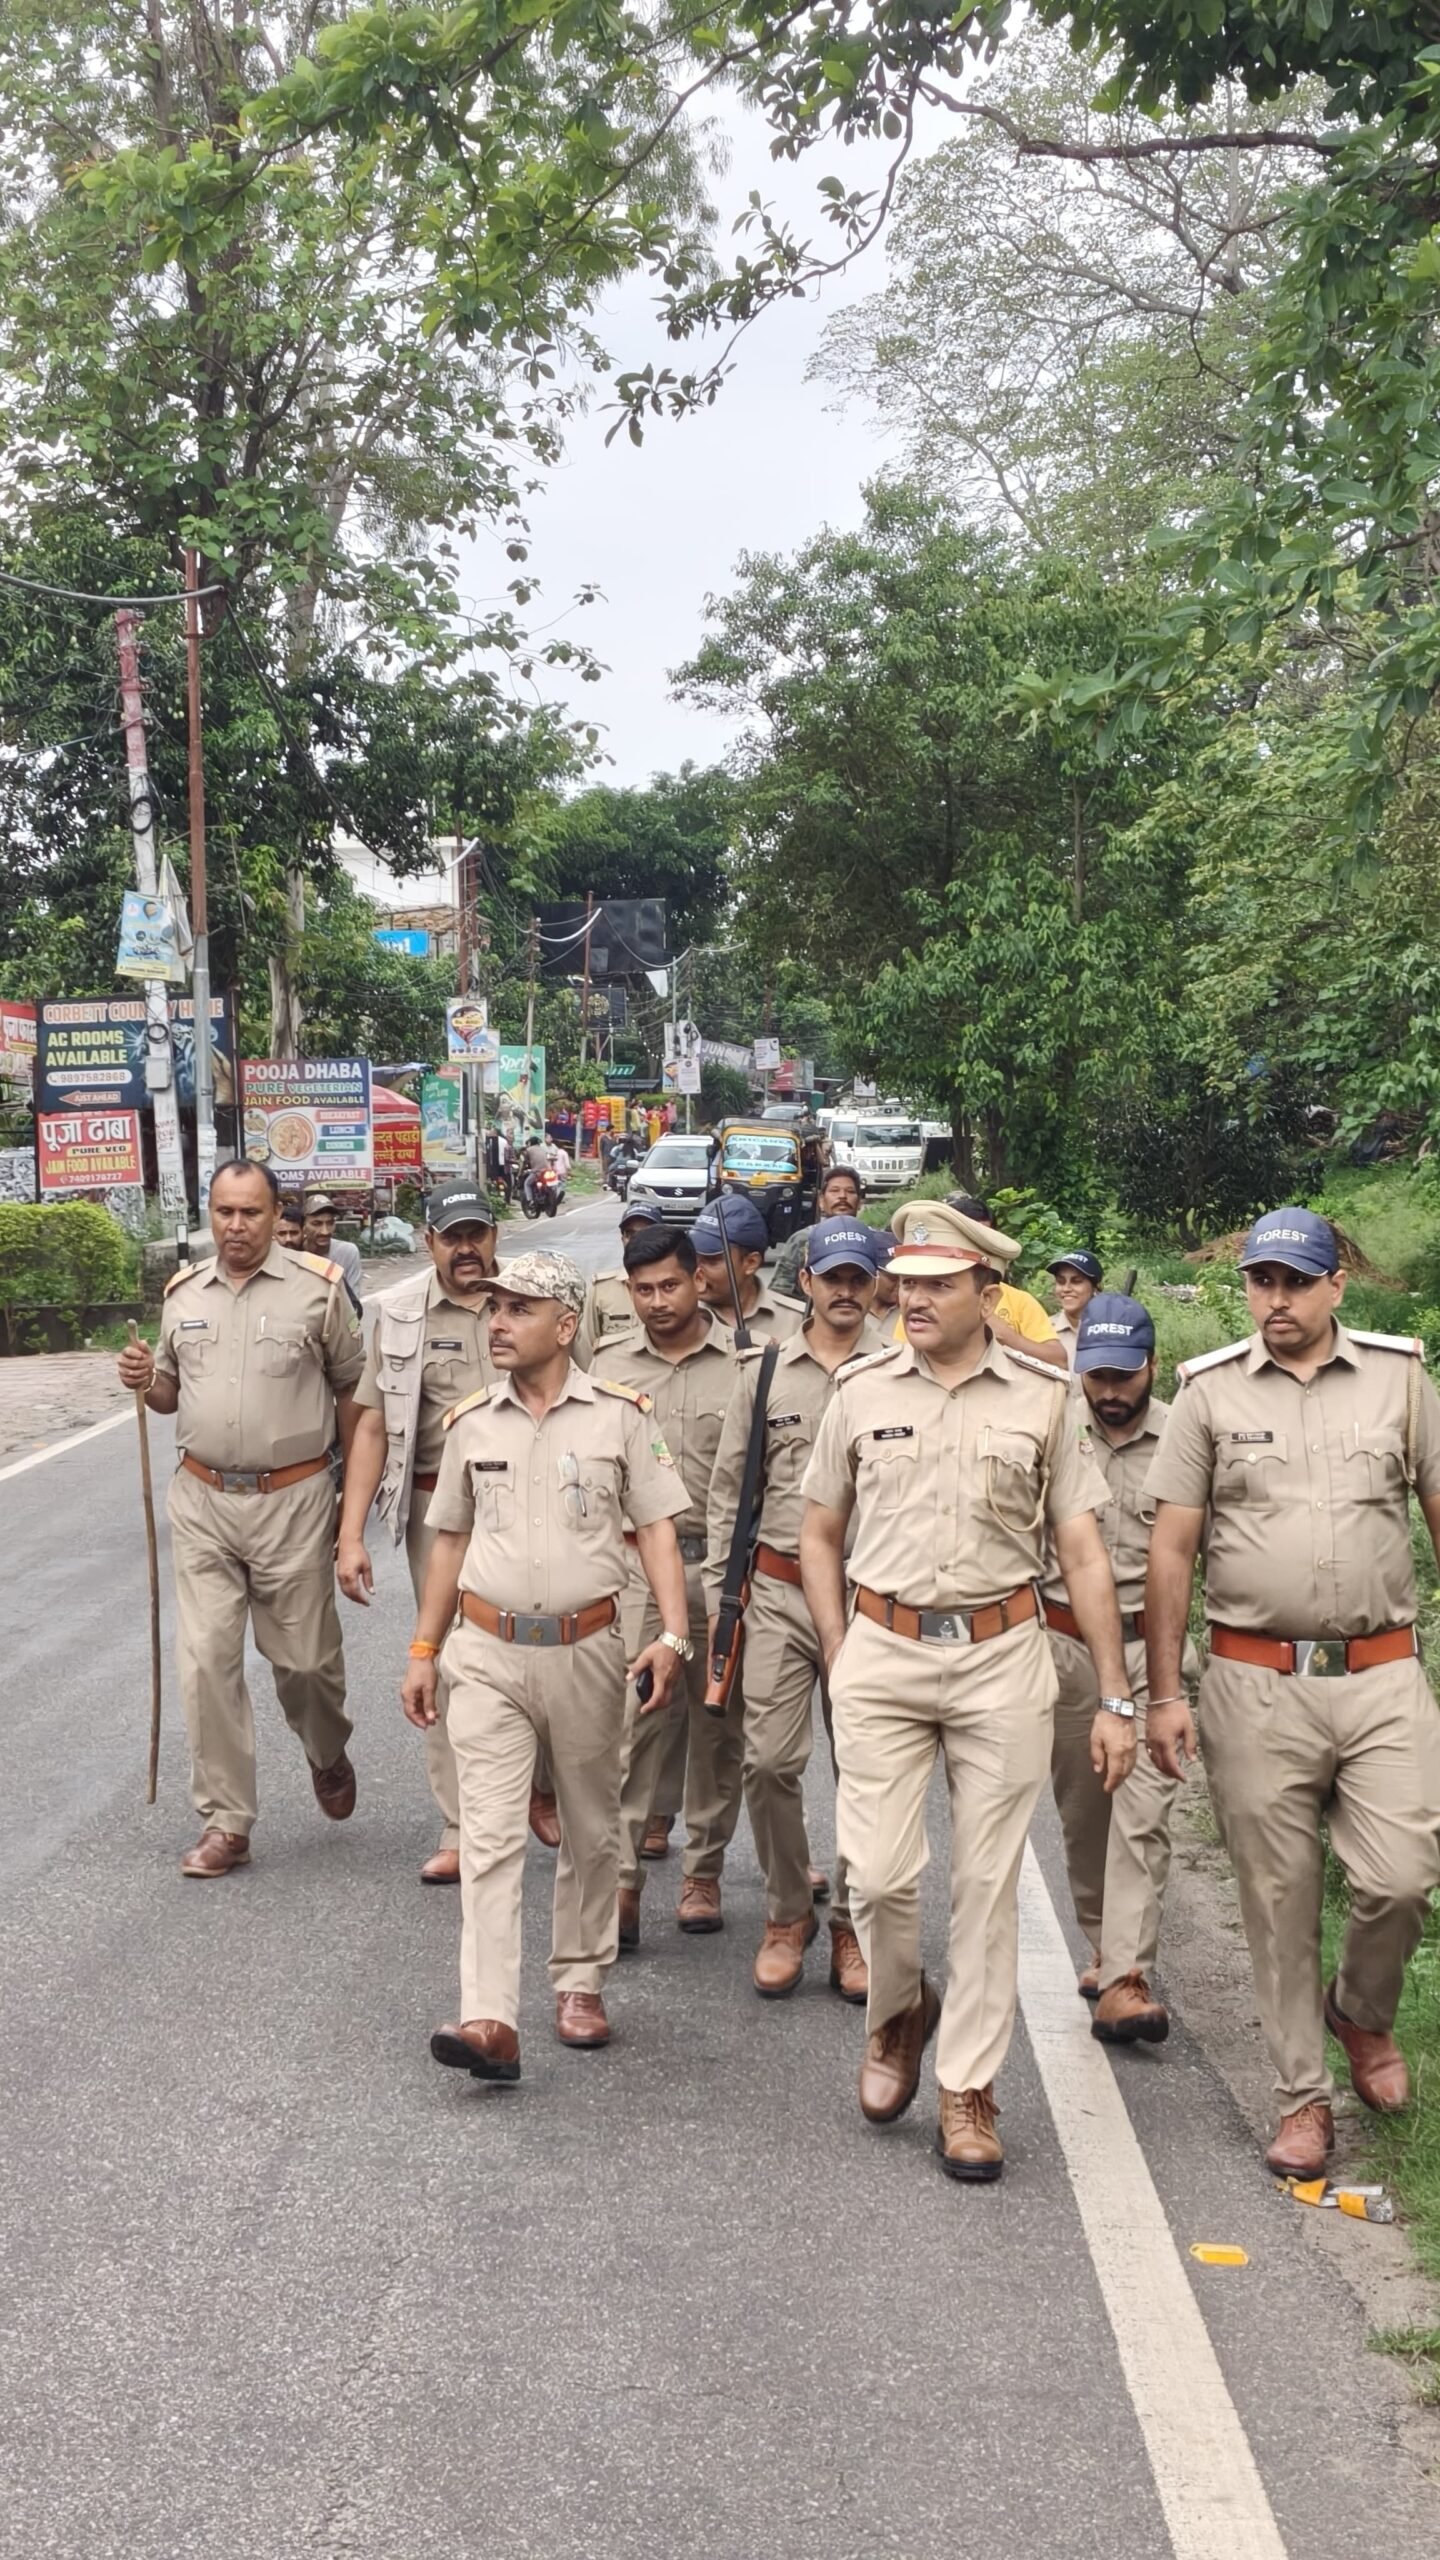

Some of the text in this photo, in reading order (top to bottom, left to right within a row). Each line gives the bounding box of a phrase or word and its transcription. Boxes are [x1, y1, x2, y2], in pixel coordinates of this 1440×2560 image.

[43, 1003, 107, 1024] CORBETT
[108, 1001, 177, 1022] COUNY
[47, 1030, 125, 1047] AC ROOMS
[46, 1049, 128, 1067] AVAILABLE
[499, 1053, 541, 1073] Sprie
[244, 1062, 363, 1081] POOJA DHABA
[245, 1081, 285, 1095] PURE
[244, 1096, 365, 1106] JAIN FOOD AVAILABLE
[41, 1120, 82, 1151] पूजा
[87, 1116, 131, 1143] ढाबा
[105, 1145, 127, 1153] VEG
[46, 1155, 136, 1174] JAIN FOOD AVAILABLE
[273, 1170, 304, 1181] OOMS
[308, 1168, 367, 1180] AVAILABLE
[443, 1193, 478, 1206] FOREST
[824, 1231, 867, 1245] FOREST
[1256, 1229, 1308, 1245] FOREST
[1087, 1323, 1134, 1337] FOREST
